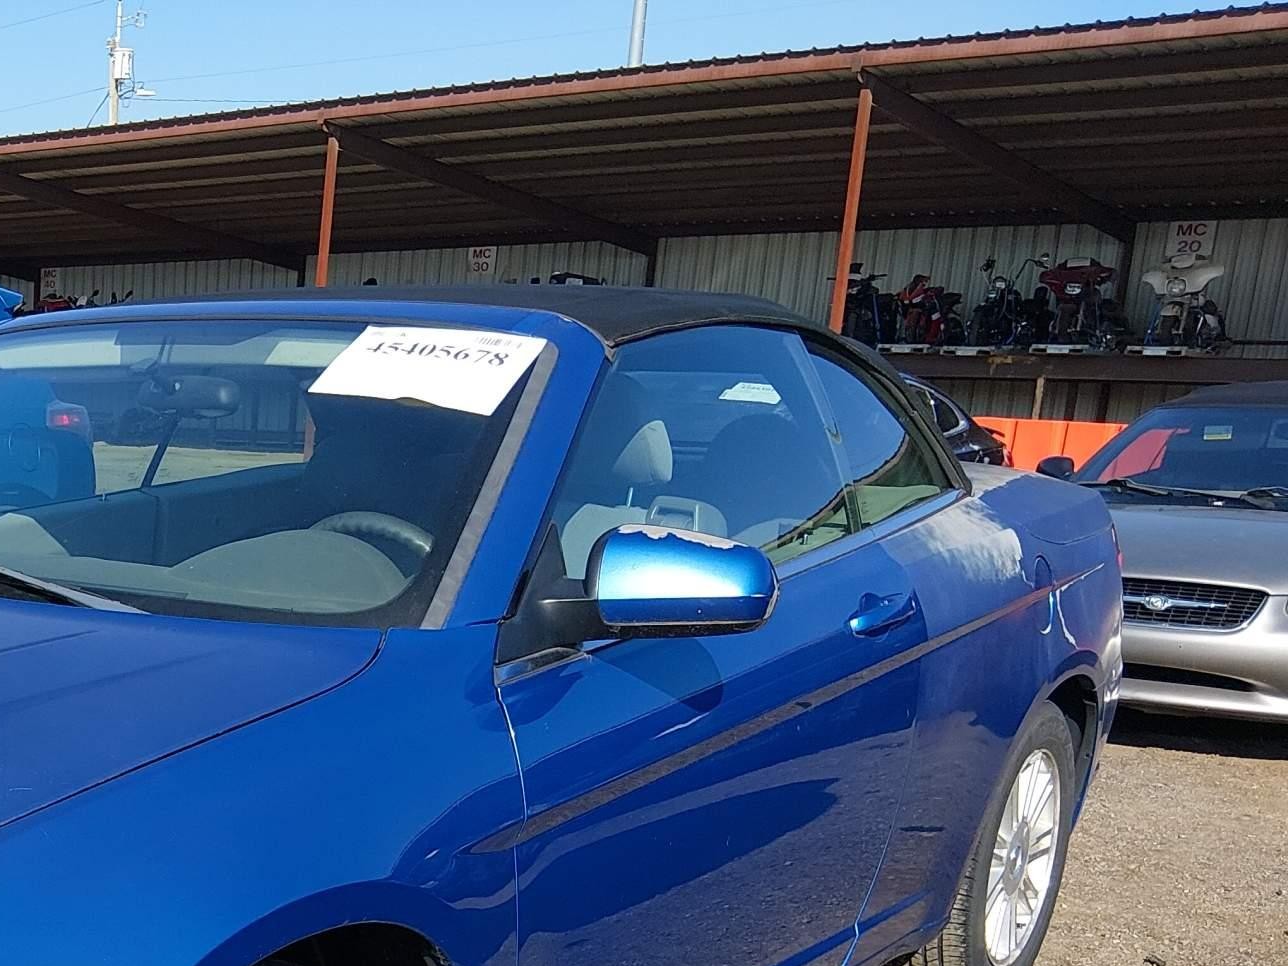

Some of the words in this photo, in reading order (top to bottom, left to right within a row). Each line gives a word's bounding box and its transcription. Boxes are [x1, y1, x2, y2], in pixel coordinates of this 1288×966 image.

[1176, 223, 1208, 237] MC
[1177, 240, 1202, 253] 20
[472, 248, 491, 259] MC
[472, 261, 489, 272] 30
[366, 341, 510, 367] 45405678
